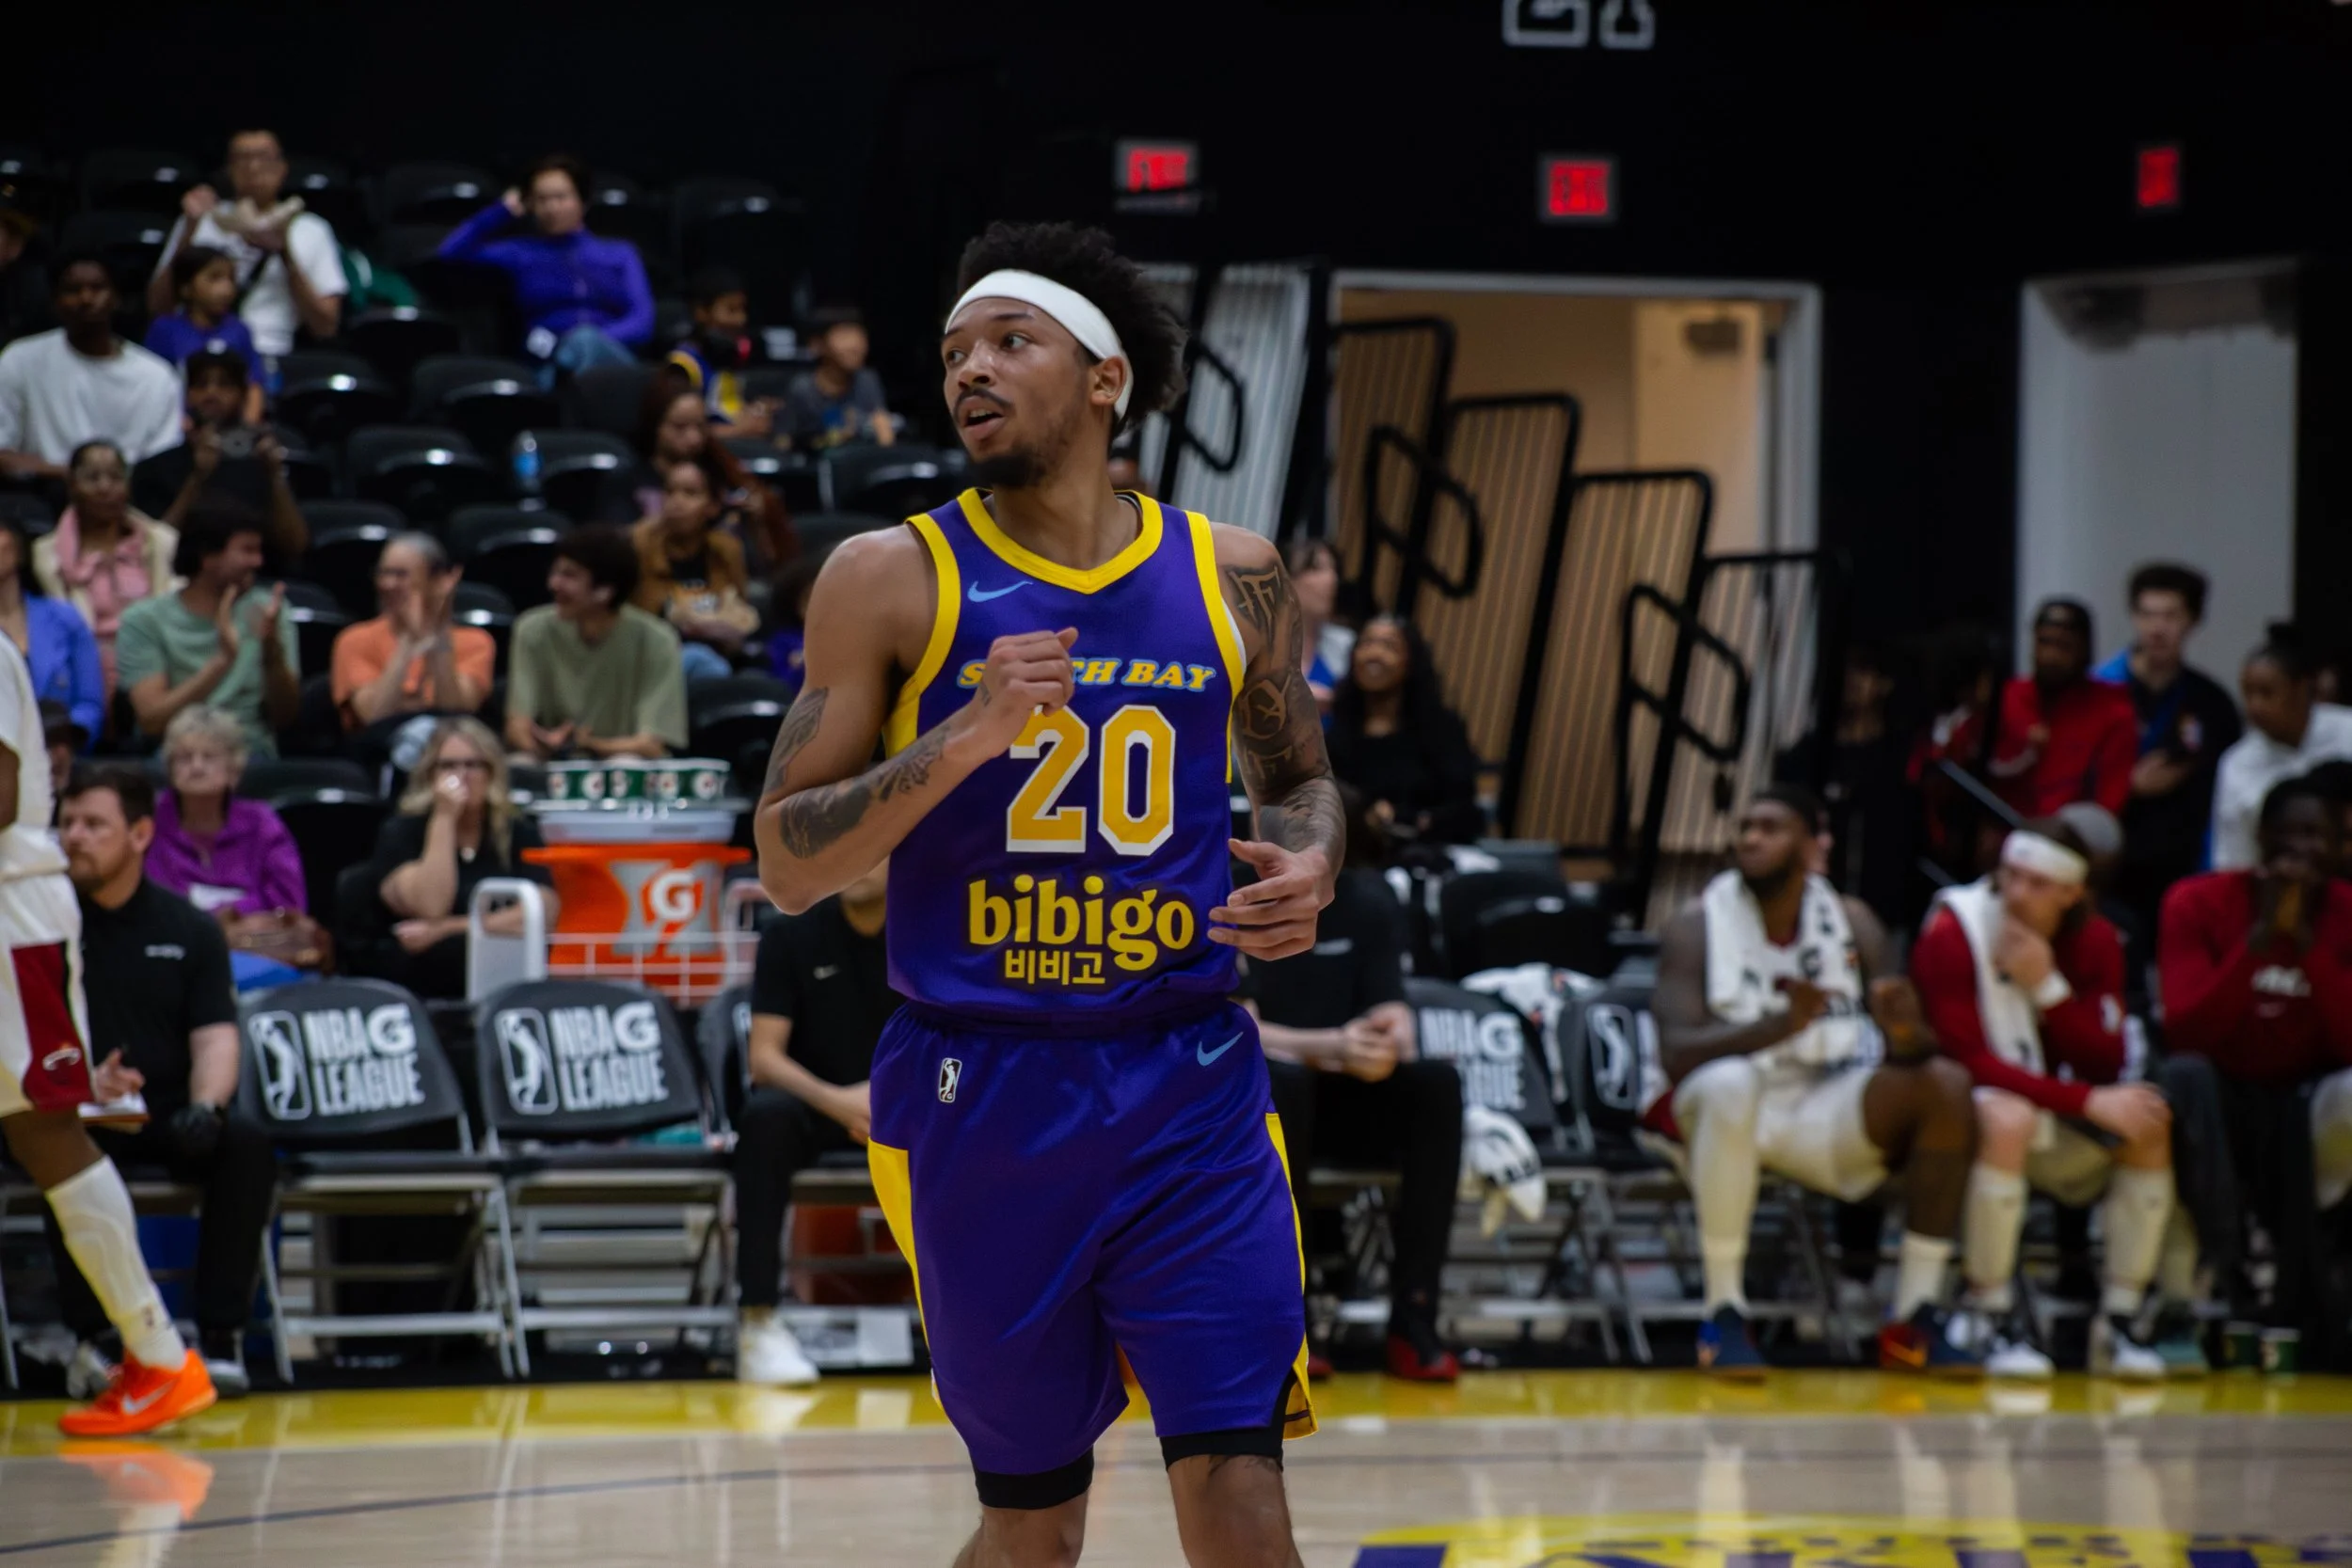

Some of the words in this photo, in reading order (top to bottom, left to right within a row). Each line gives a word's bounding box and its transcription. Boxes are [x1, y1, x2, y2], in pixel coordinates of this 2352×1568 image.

[1124, 658, 1216, 691] BAY
[1006, 705, 1176, 856] 20
[649, 870, 699, 920] G
[969, 874, 1194, 971] bibigo
[1005, 949, 1105, 985] 비비고
[313, 1053, 426, 1116] LEAGUE
[562, 1052, 670, 1111] LEAGUE
